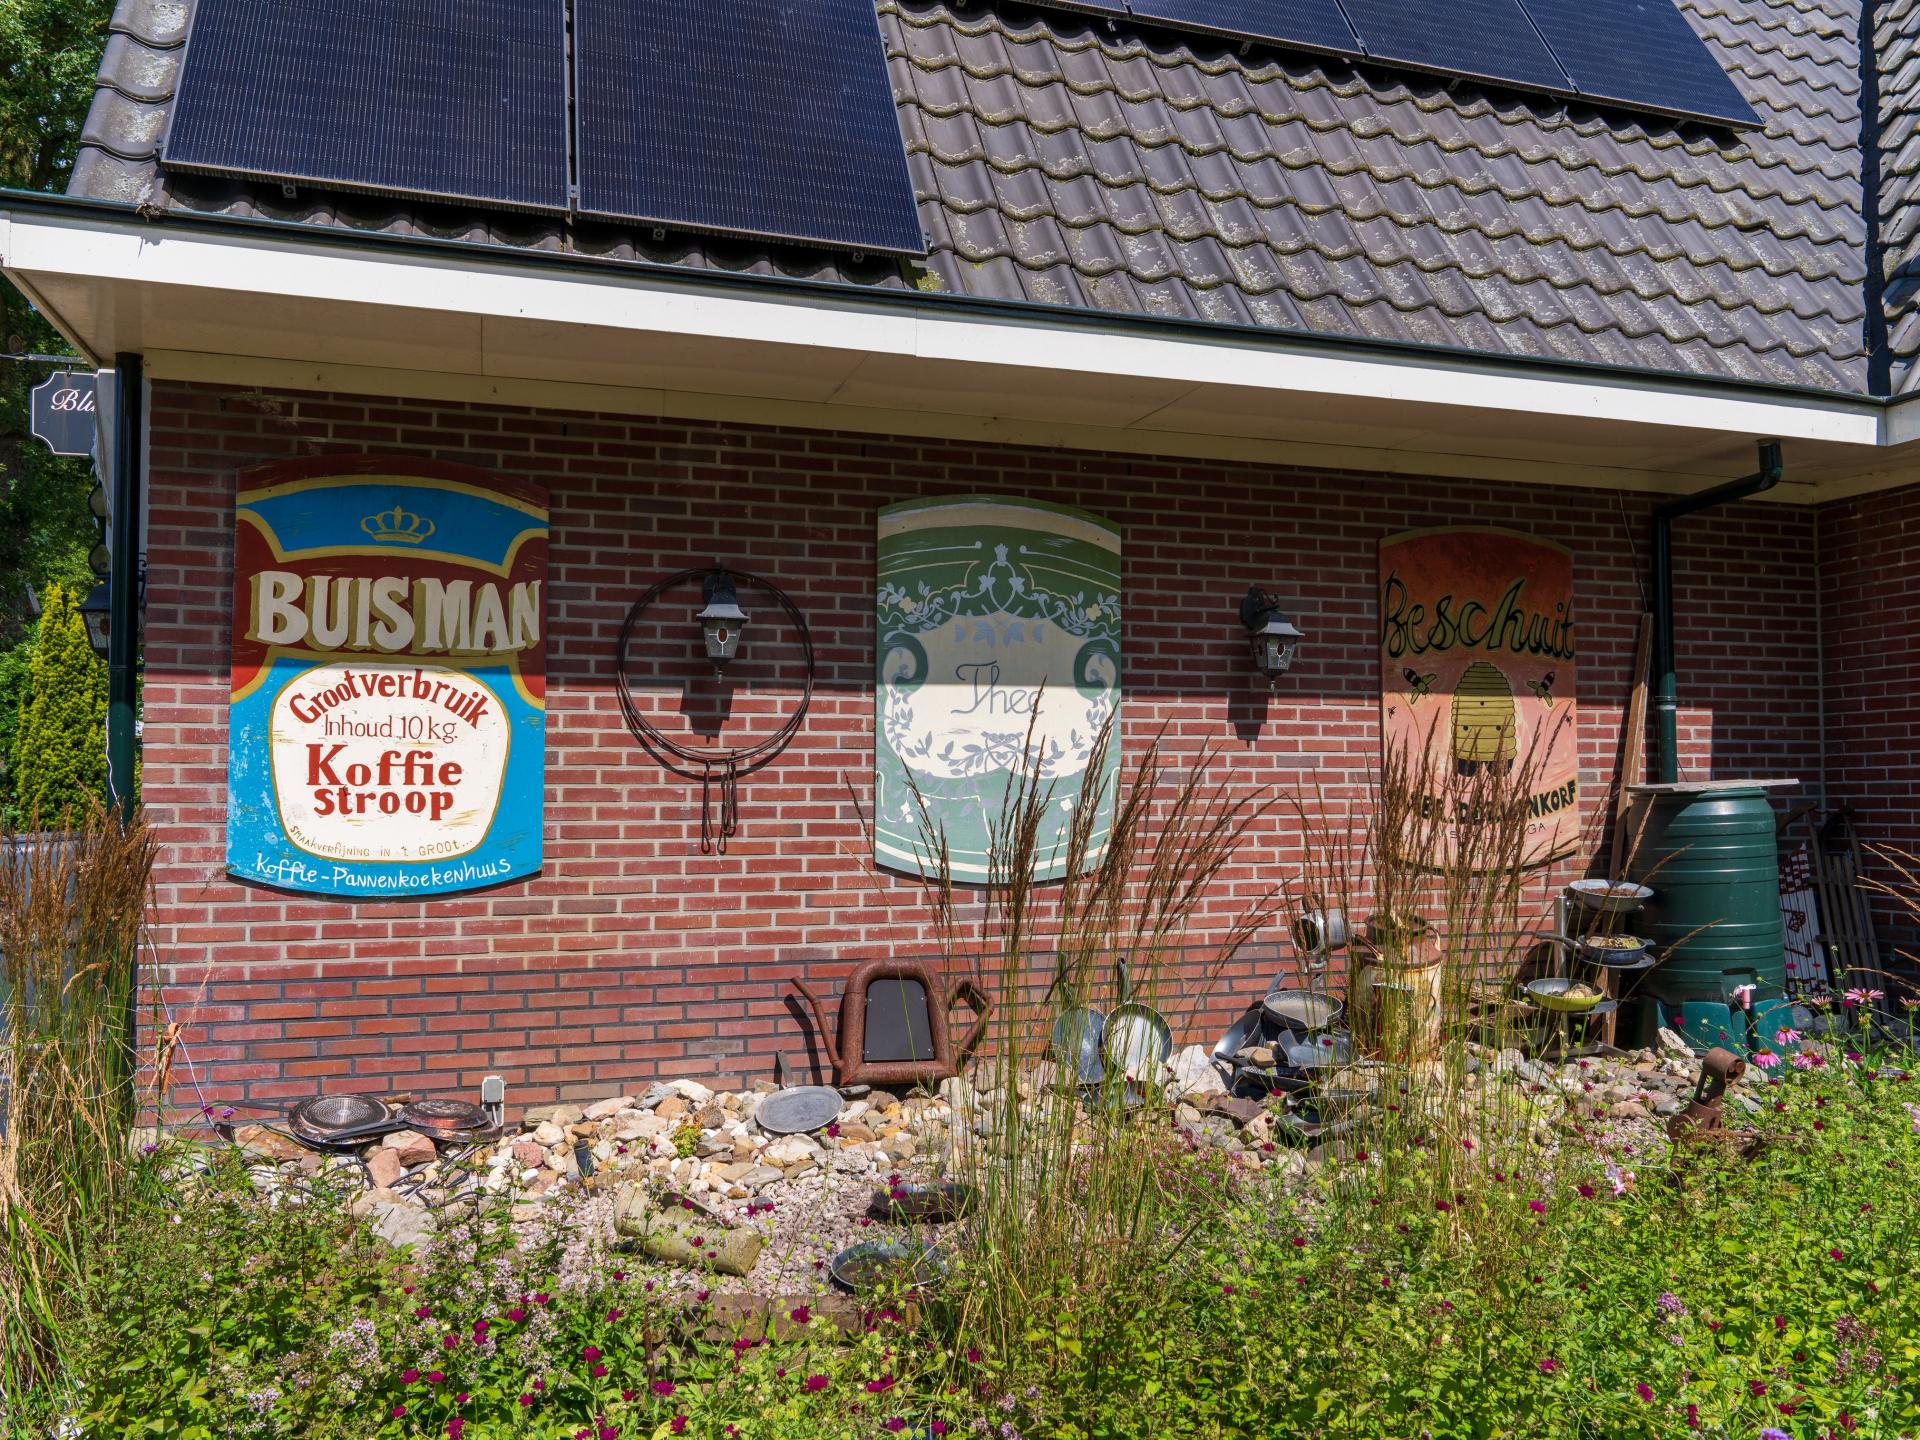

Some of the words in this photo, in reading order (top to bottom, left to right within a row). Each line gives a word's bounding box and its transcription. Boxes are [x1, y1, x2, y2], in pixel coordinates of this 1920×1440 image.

[250, 570, 542, 656] BUISMAN
[289, 668, 489, 730] Grootverbruik
[951, 660, 1046, 715] Thee
[324, 714, 393, 738] Inhoud
[401, 715, 424, 740] 10
[305, 743, 463, 787] Koffie
[313, 786, 454, 821] stroop
